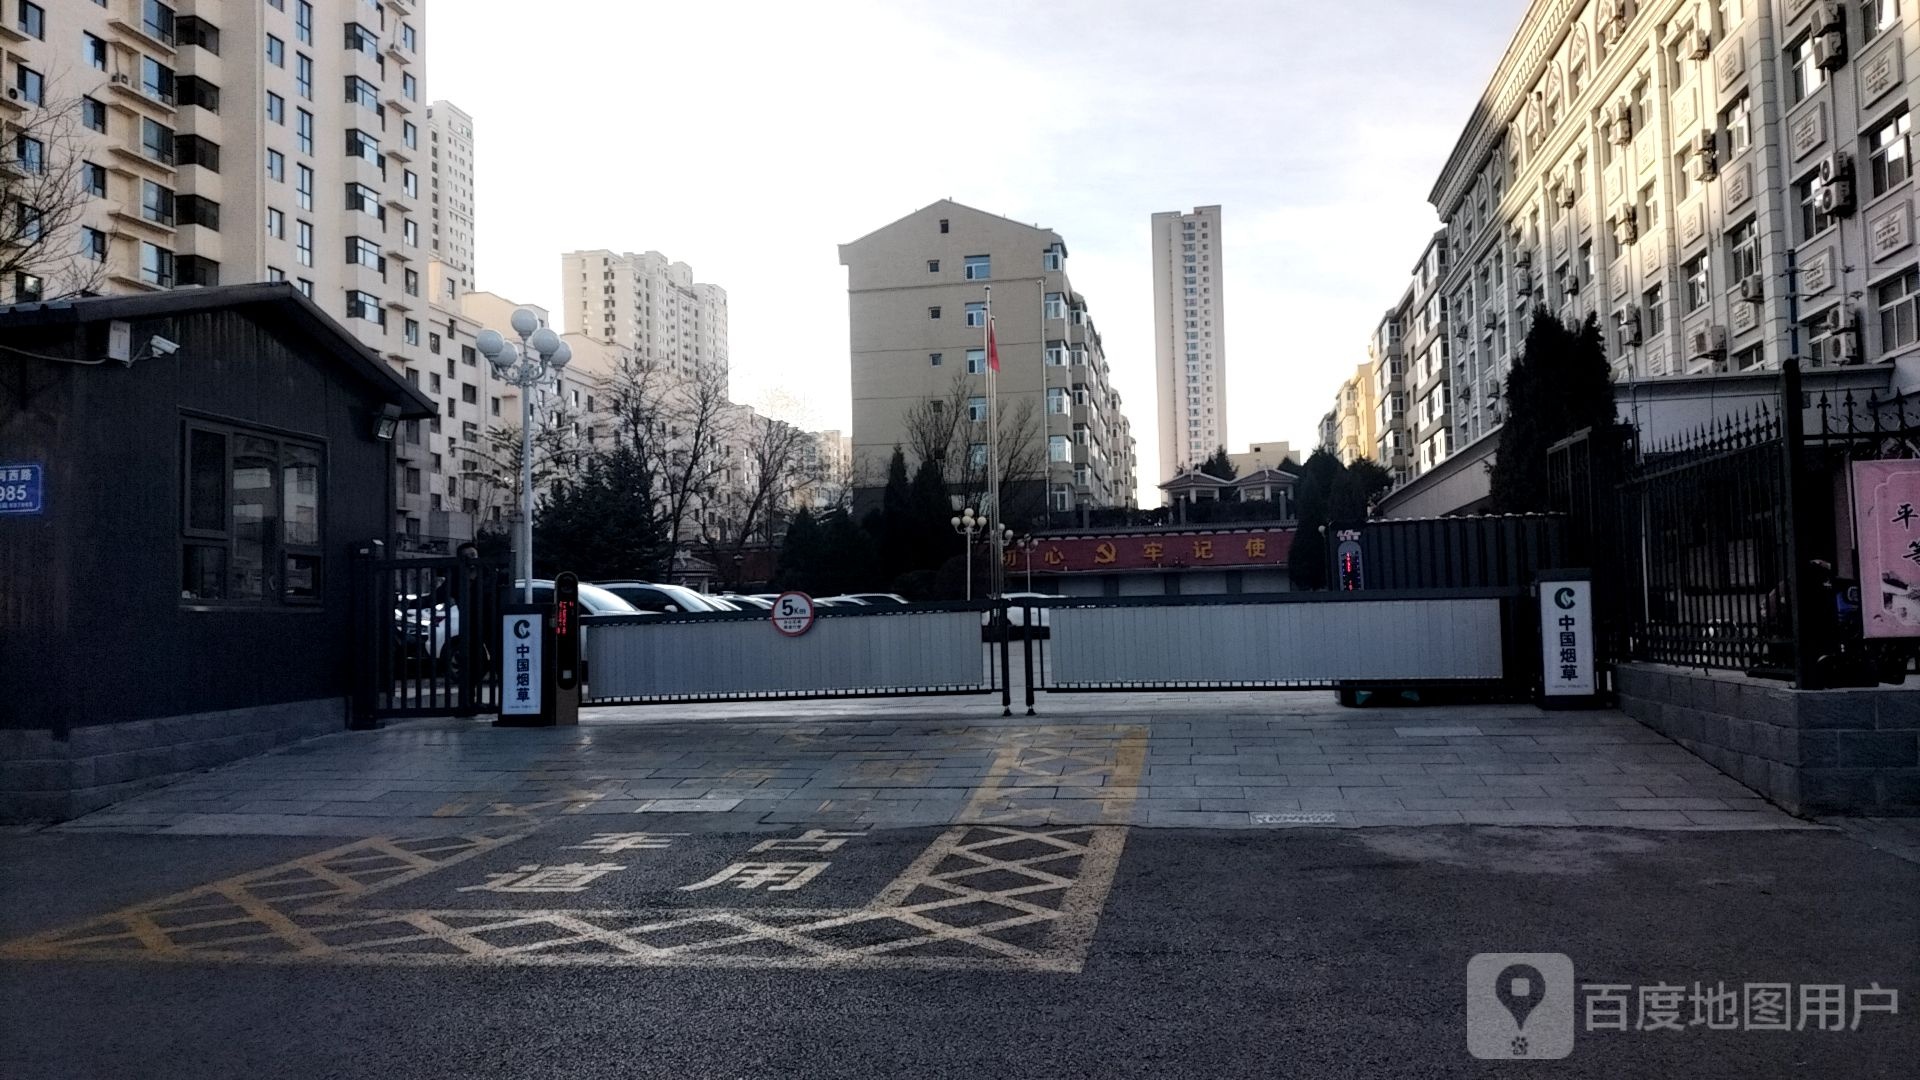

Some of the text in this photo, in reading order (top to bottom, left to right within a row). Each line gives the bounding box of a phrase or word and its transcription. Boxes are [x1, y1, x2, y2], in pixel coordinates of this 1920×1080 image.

[516, 643, 530, 702] 中国烟草
[1558, 614, 1579, 681] 中国烟草
